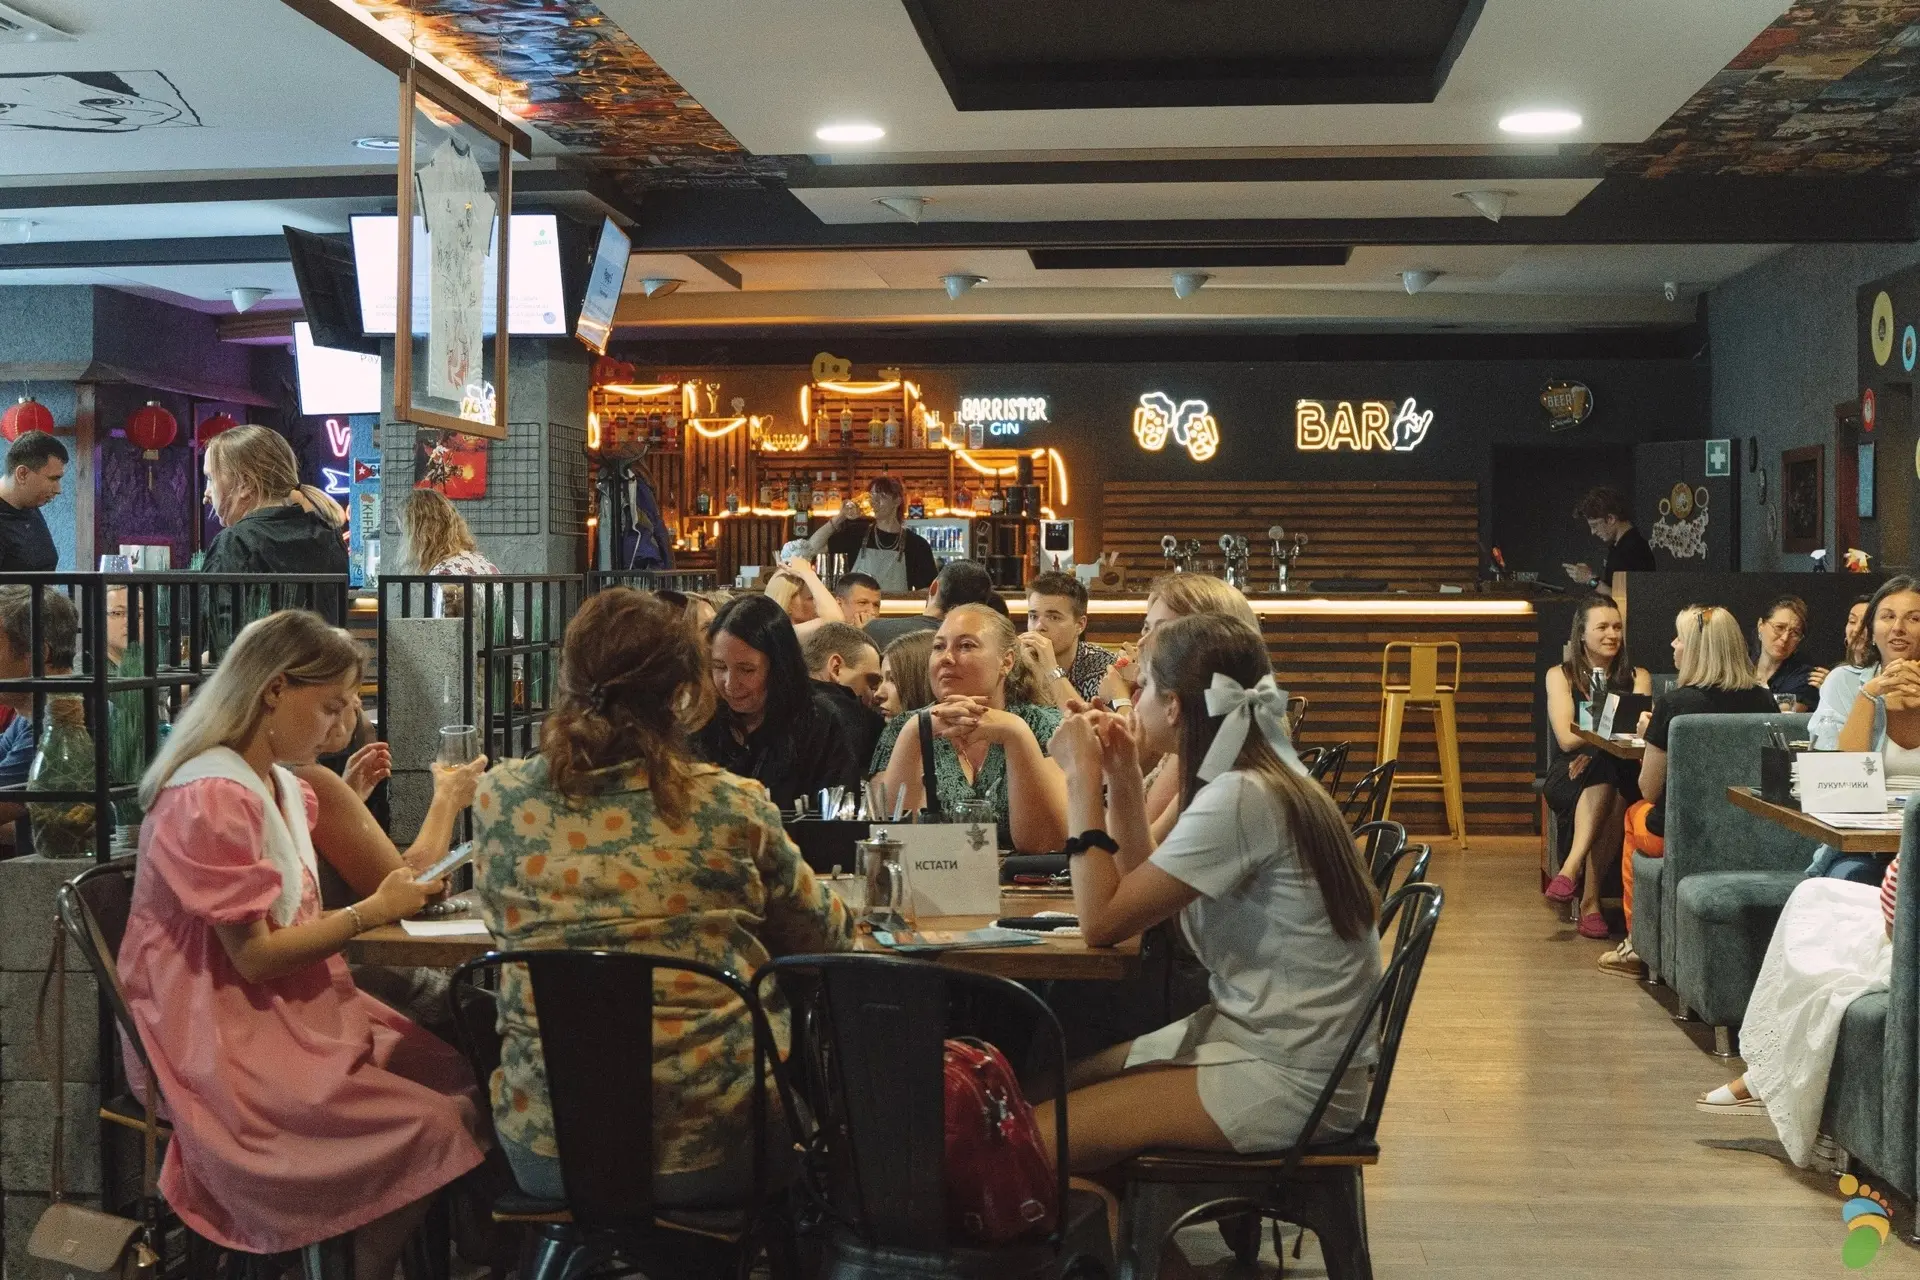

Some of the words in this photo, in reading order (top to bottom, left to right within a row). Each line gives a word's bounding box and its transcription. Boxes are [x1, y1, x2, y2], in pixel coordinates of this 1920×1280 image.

[961, 397, 1048, 421] BARRISTER
[989, 421, 1020, 436] GIN
[1296, 400, 1393, 451] BAR
[1817, 781, 1869, 790] ЛУКУМЧИКИ
[915, 859, 958, 871] КСТАТИ
